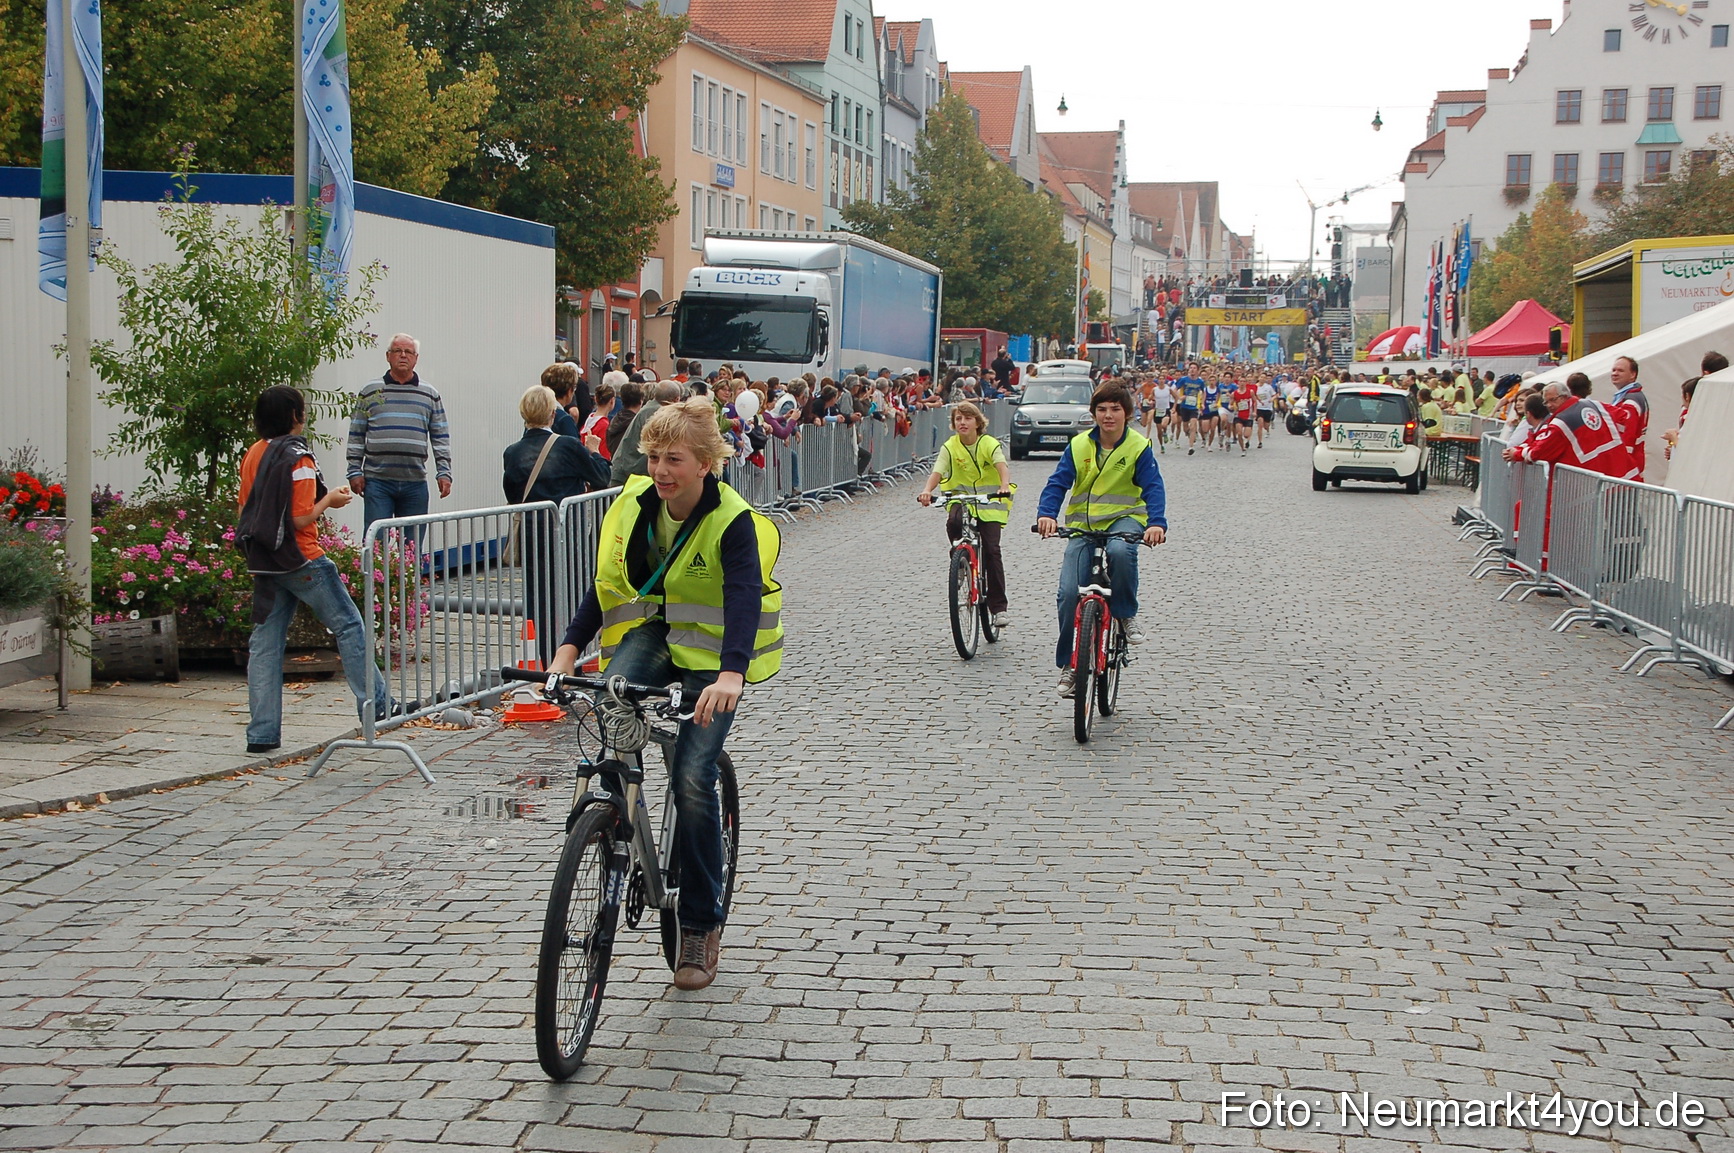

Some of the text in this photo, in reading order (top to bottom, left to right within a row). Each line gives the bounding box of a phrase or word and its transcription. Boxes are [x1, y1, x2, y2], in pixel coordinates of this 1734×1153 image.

[1662, 249, 1734, 279] Getränk
[716, 271, 782, 286] BOCK
[1661, 286, 1720, 299] NEUMARKT'S
[1223, 311, 1265, 322] START
